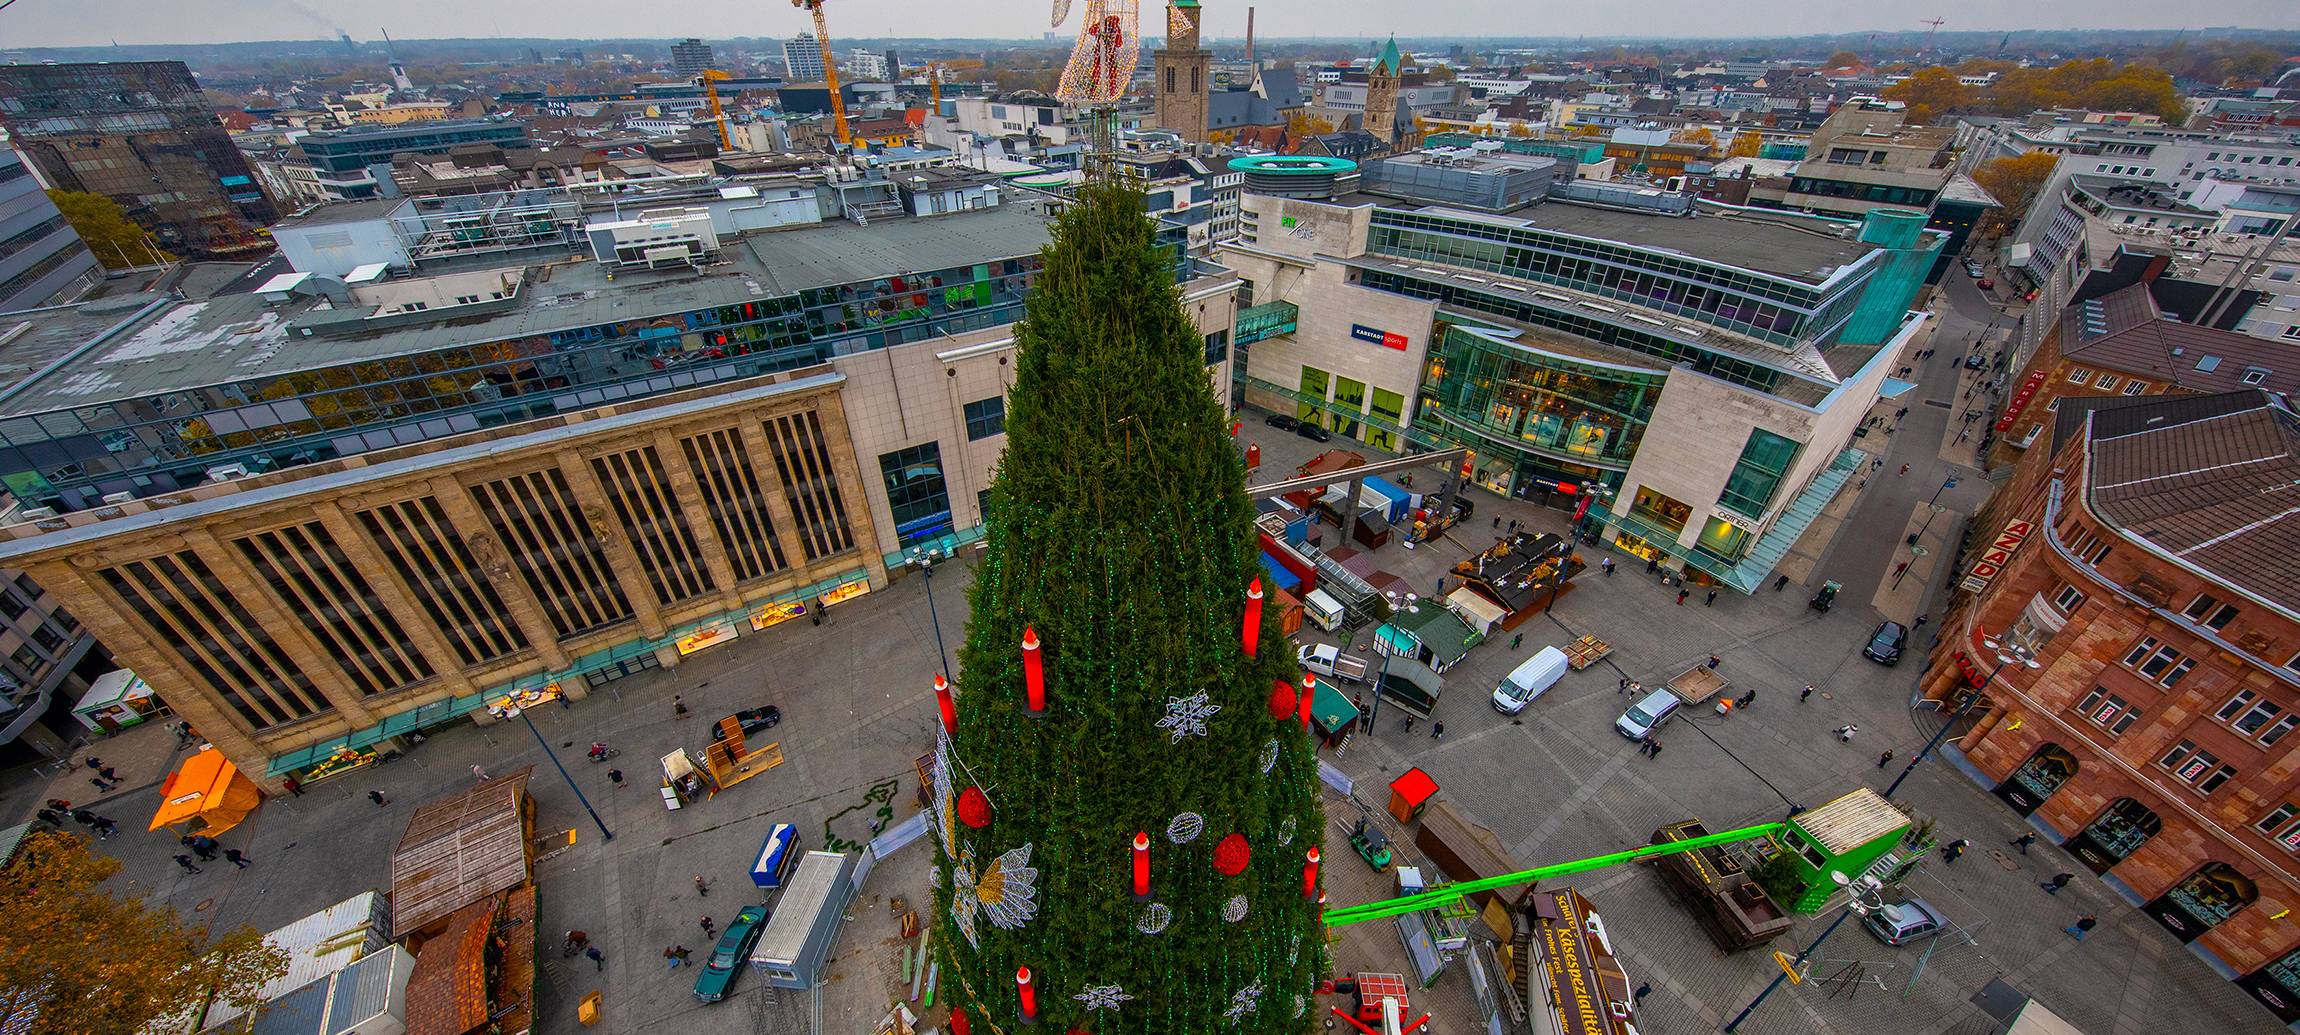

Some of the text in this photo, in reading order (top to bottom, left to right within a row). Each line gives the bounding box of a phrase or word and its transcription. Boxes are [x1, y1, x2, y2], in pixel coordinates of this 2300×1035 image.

[1281, 216, 1296, 228] FIT
[1356, 329, 1384, 340] KARSTADT
[1973, 522, 2030, 578] AZAD
[1953, 651, 1985, 689] AZAD
[1545, 929, 1557, 955] Frohes
[1552, 956, 1563, 974] Fest
